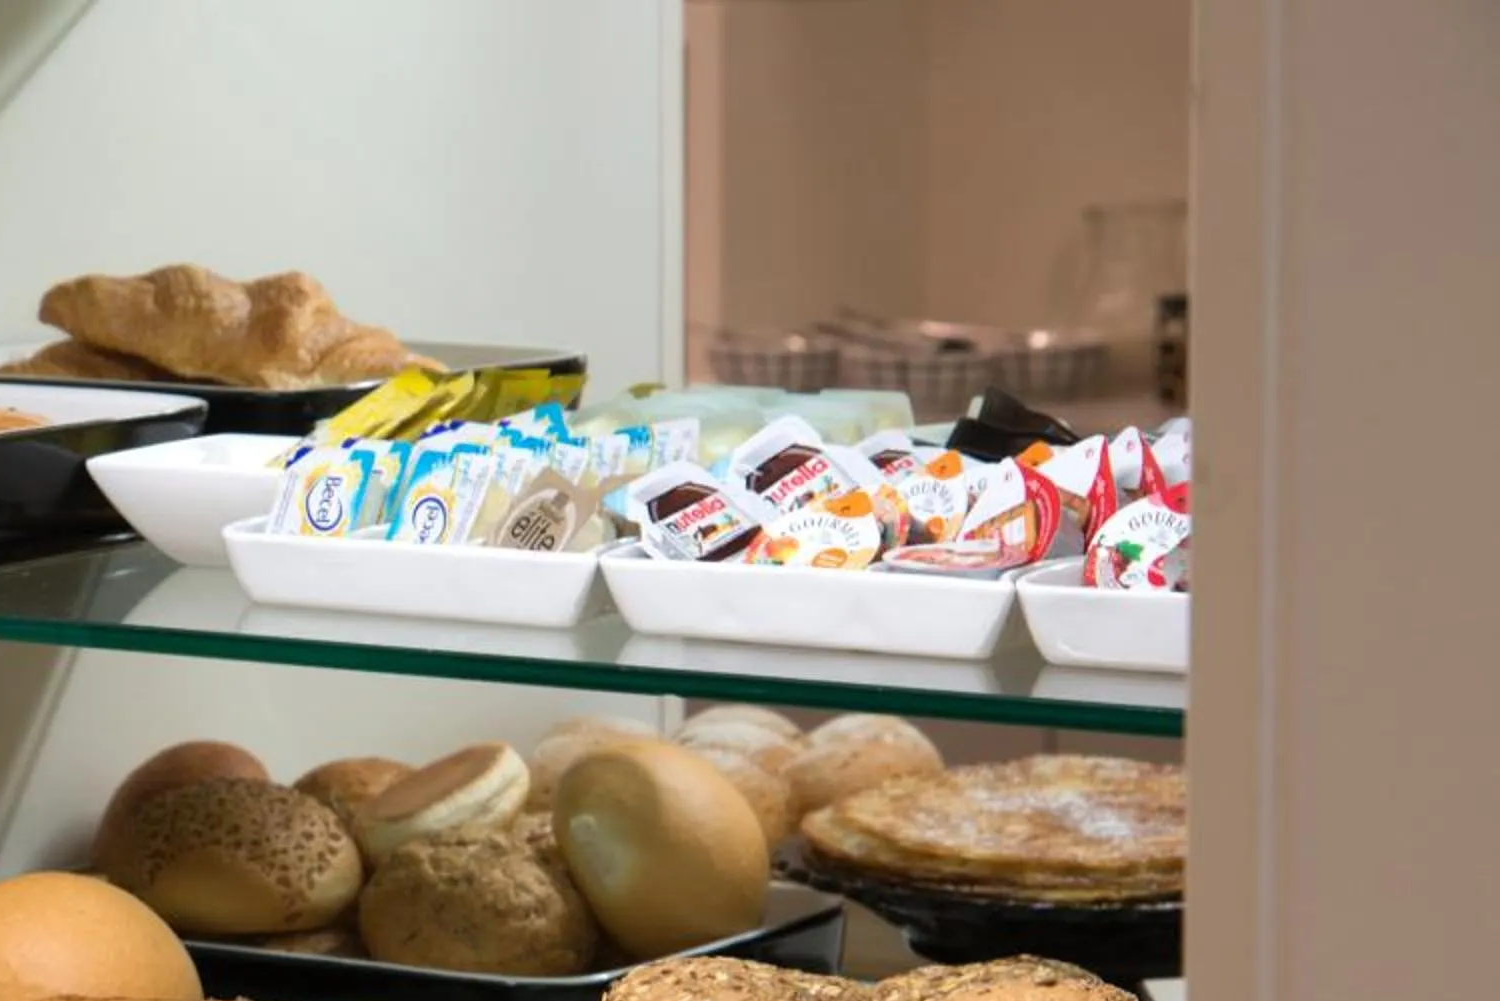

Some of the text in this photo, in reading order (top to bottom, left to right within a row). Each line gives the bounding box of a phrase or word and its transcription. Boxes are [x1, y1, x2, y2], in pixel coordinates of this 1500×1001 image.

[315, 475, 343, 523] Becel
[762, 456, 829, 509] nutella
[665, 496, 727, 534] nutella
